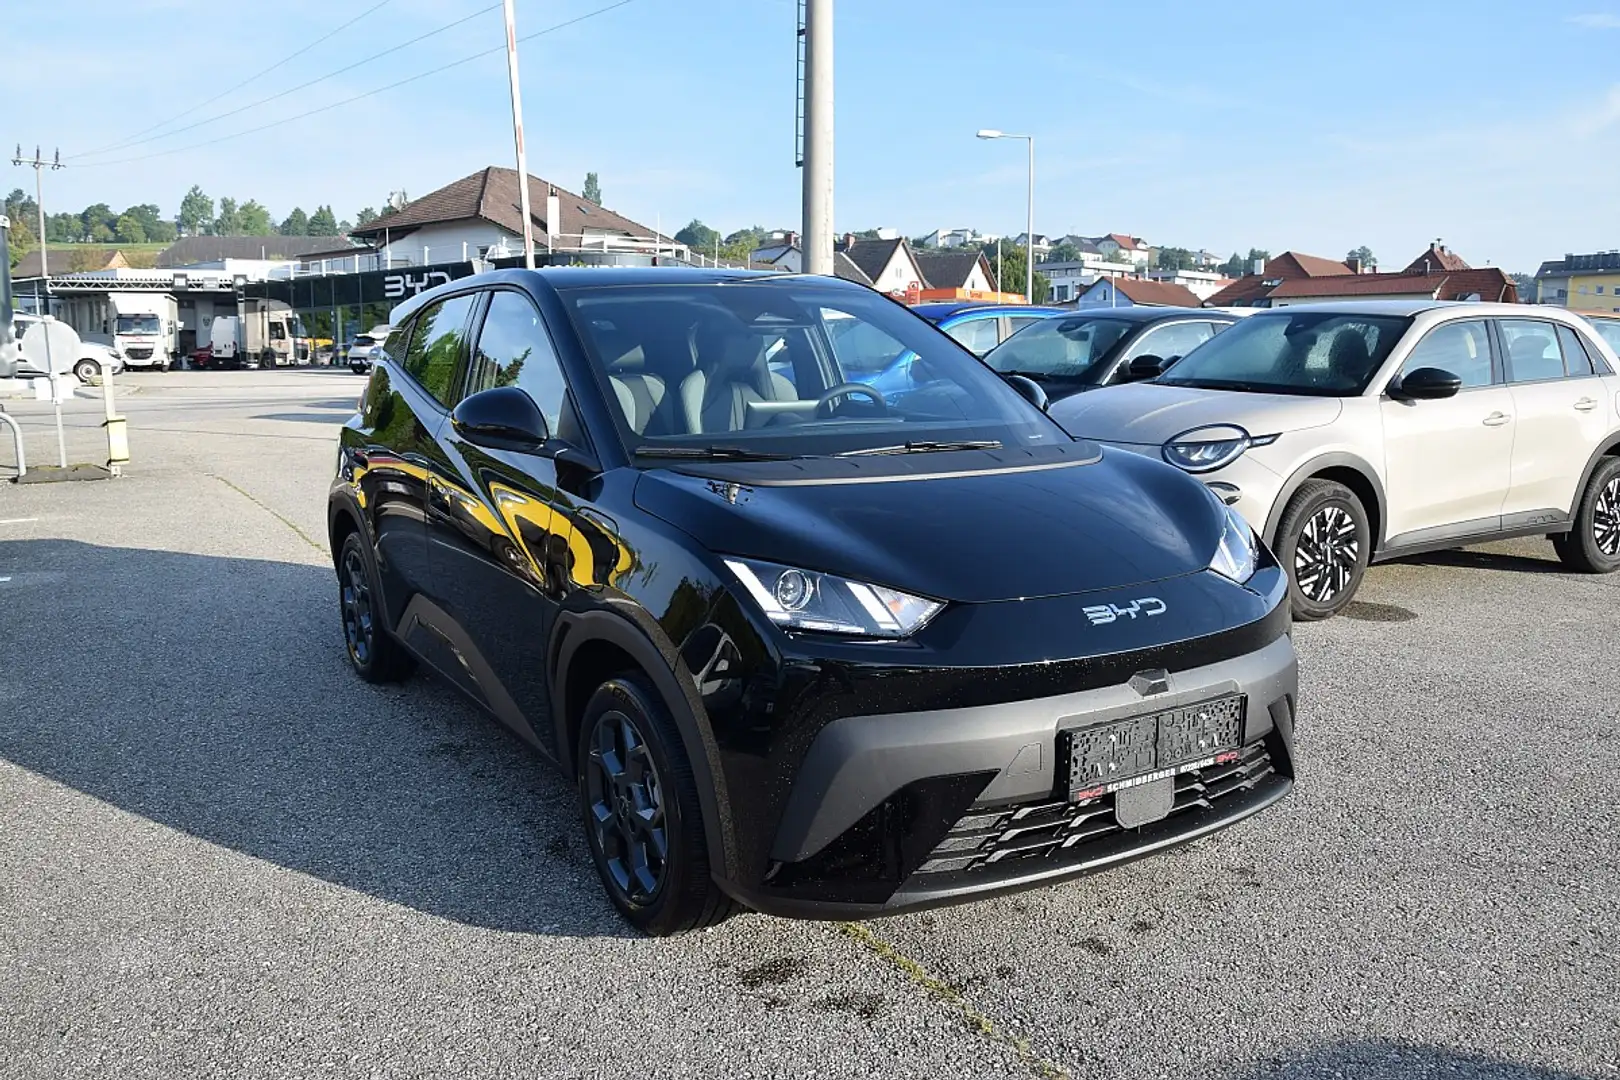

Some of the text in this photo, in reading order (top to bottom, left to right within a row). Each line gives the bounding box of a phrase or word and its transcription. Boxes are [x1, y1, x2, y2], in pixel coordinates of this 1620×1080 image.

[1082, 597, 1167, 626] BYD
[1078, 785, 1104, 800] BYD
[1106, 768, 1176, 792] SCHMIDBERGER
[1216, 751, 1238, 763] BYD
